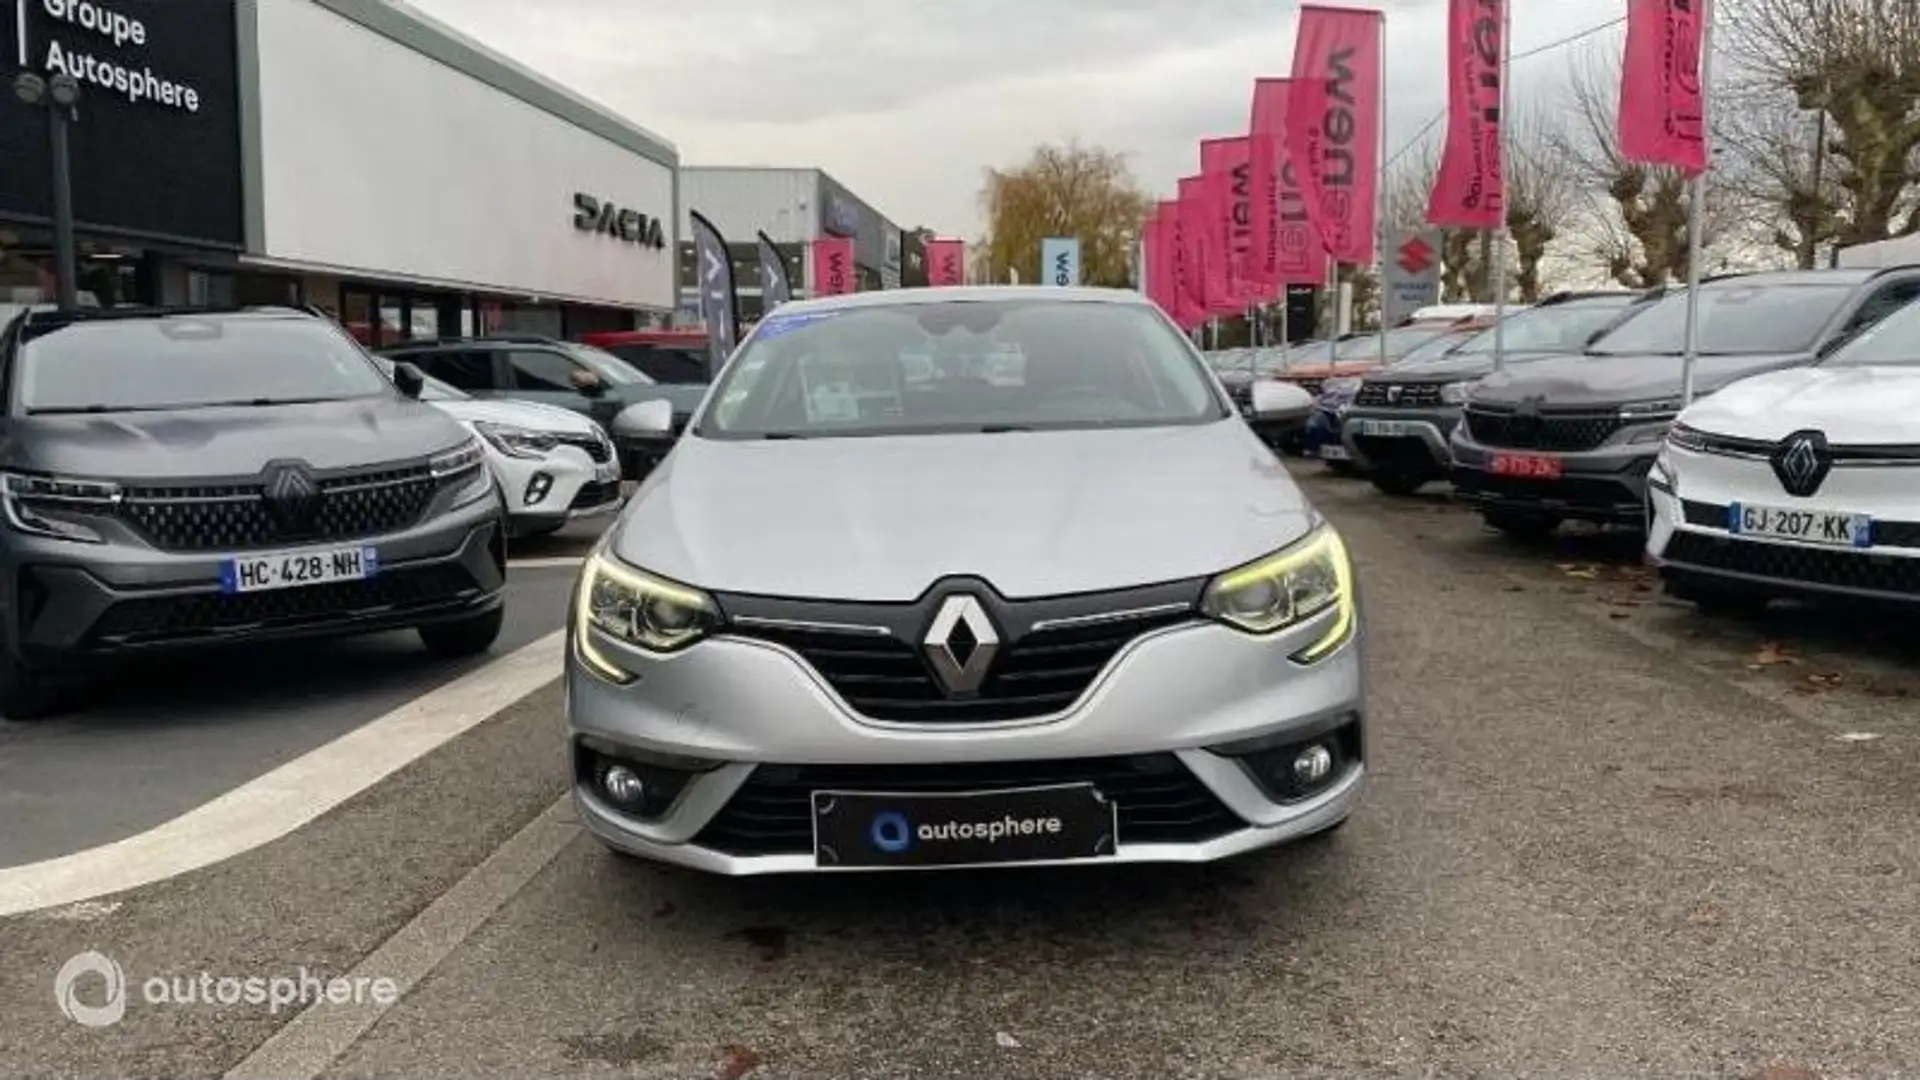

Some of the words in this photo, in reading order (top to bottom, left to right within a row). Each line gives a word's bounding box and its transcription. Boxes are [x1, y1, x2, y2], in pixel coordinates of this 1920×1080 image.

[46, 40, 200, 112] Autosphere
[574, 192, 666, 249] DACIA
[917, 815, 1062, 843] autosphere
